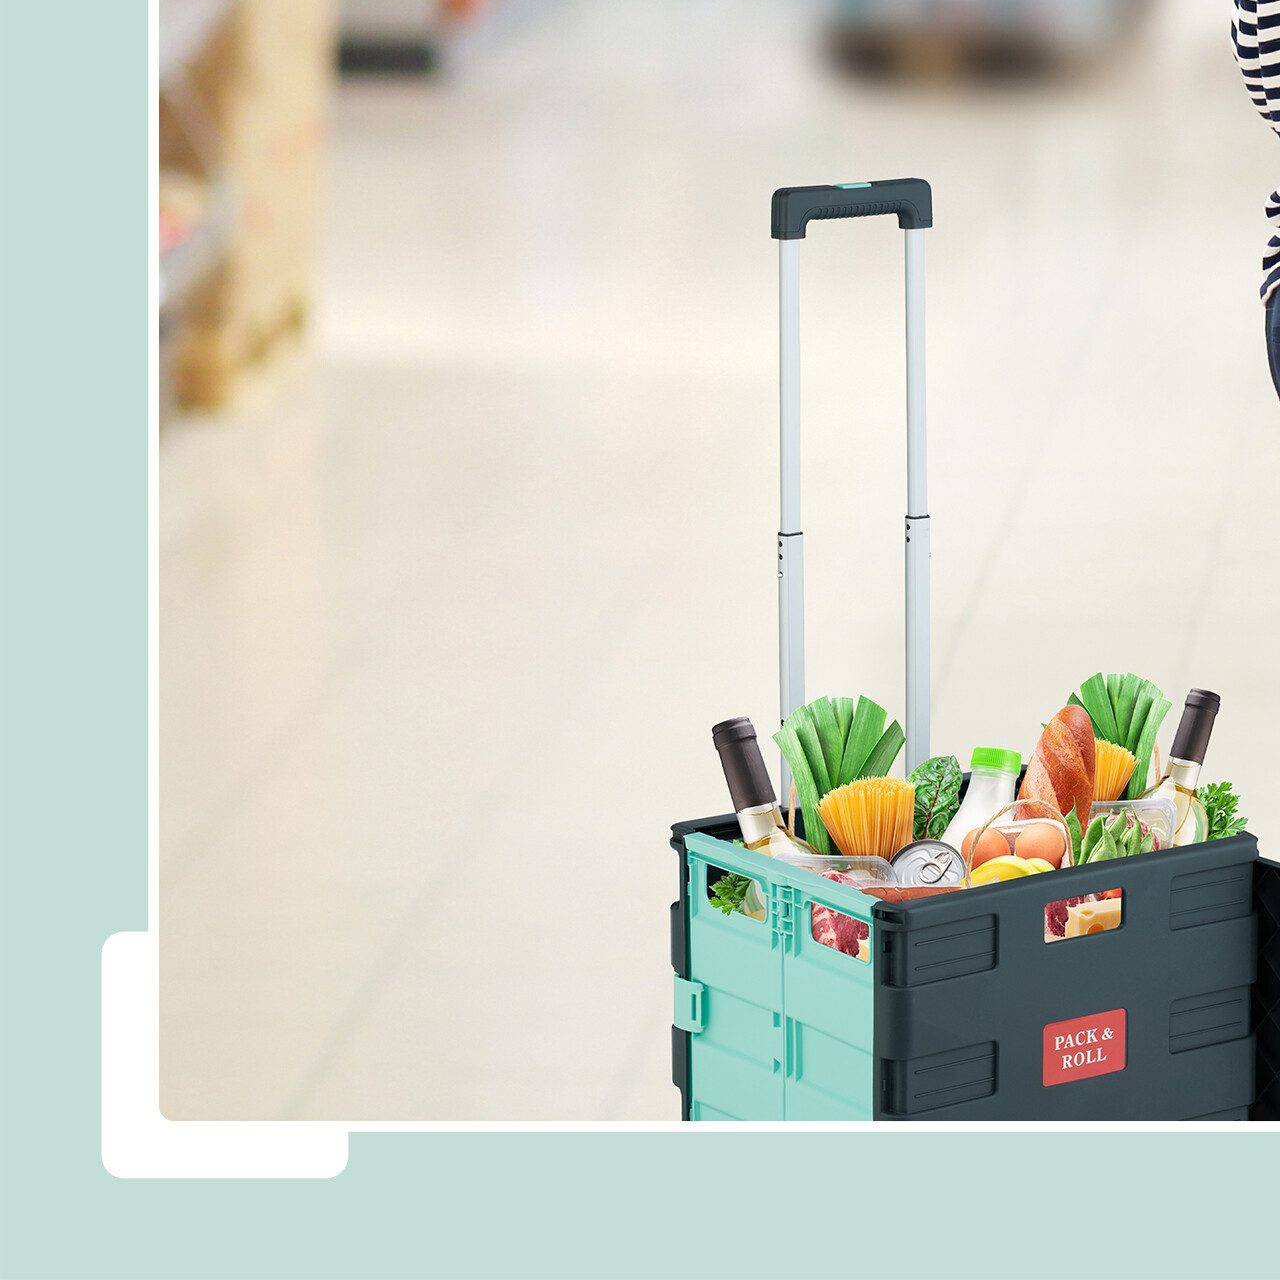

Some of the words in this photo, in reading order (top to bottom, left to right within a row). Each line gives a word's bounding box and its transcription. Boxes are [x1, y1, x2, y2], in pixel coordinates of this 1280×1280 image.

[1054, 1028, 1098, 1051] PACK
[1101, 1027, 1114, 1041] &
[1061, 1047, 1107, 1070] ROLL
